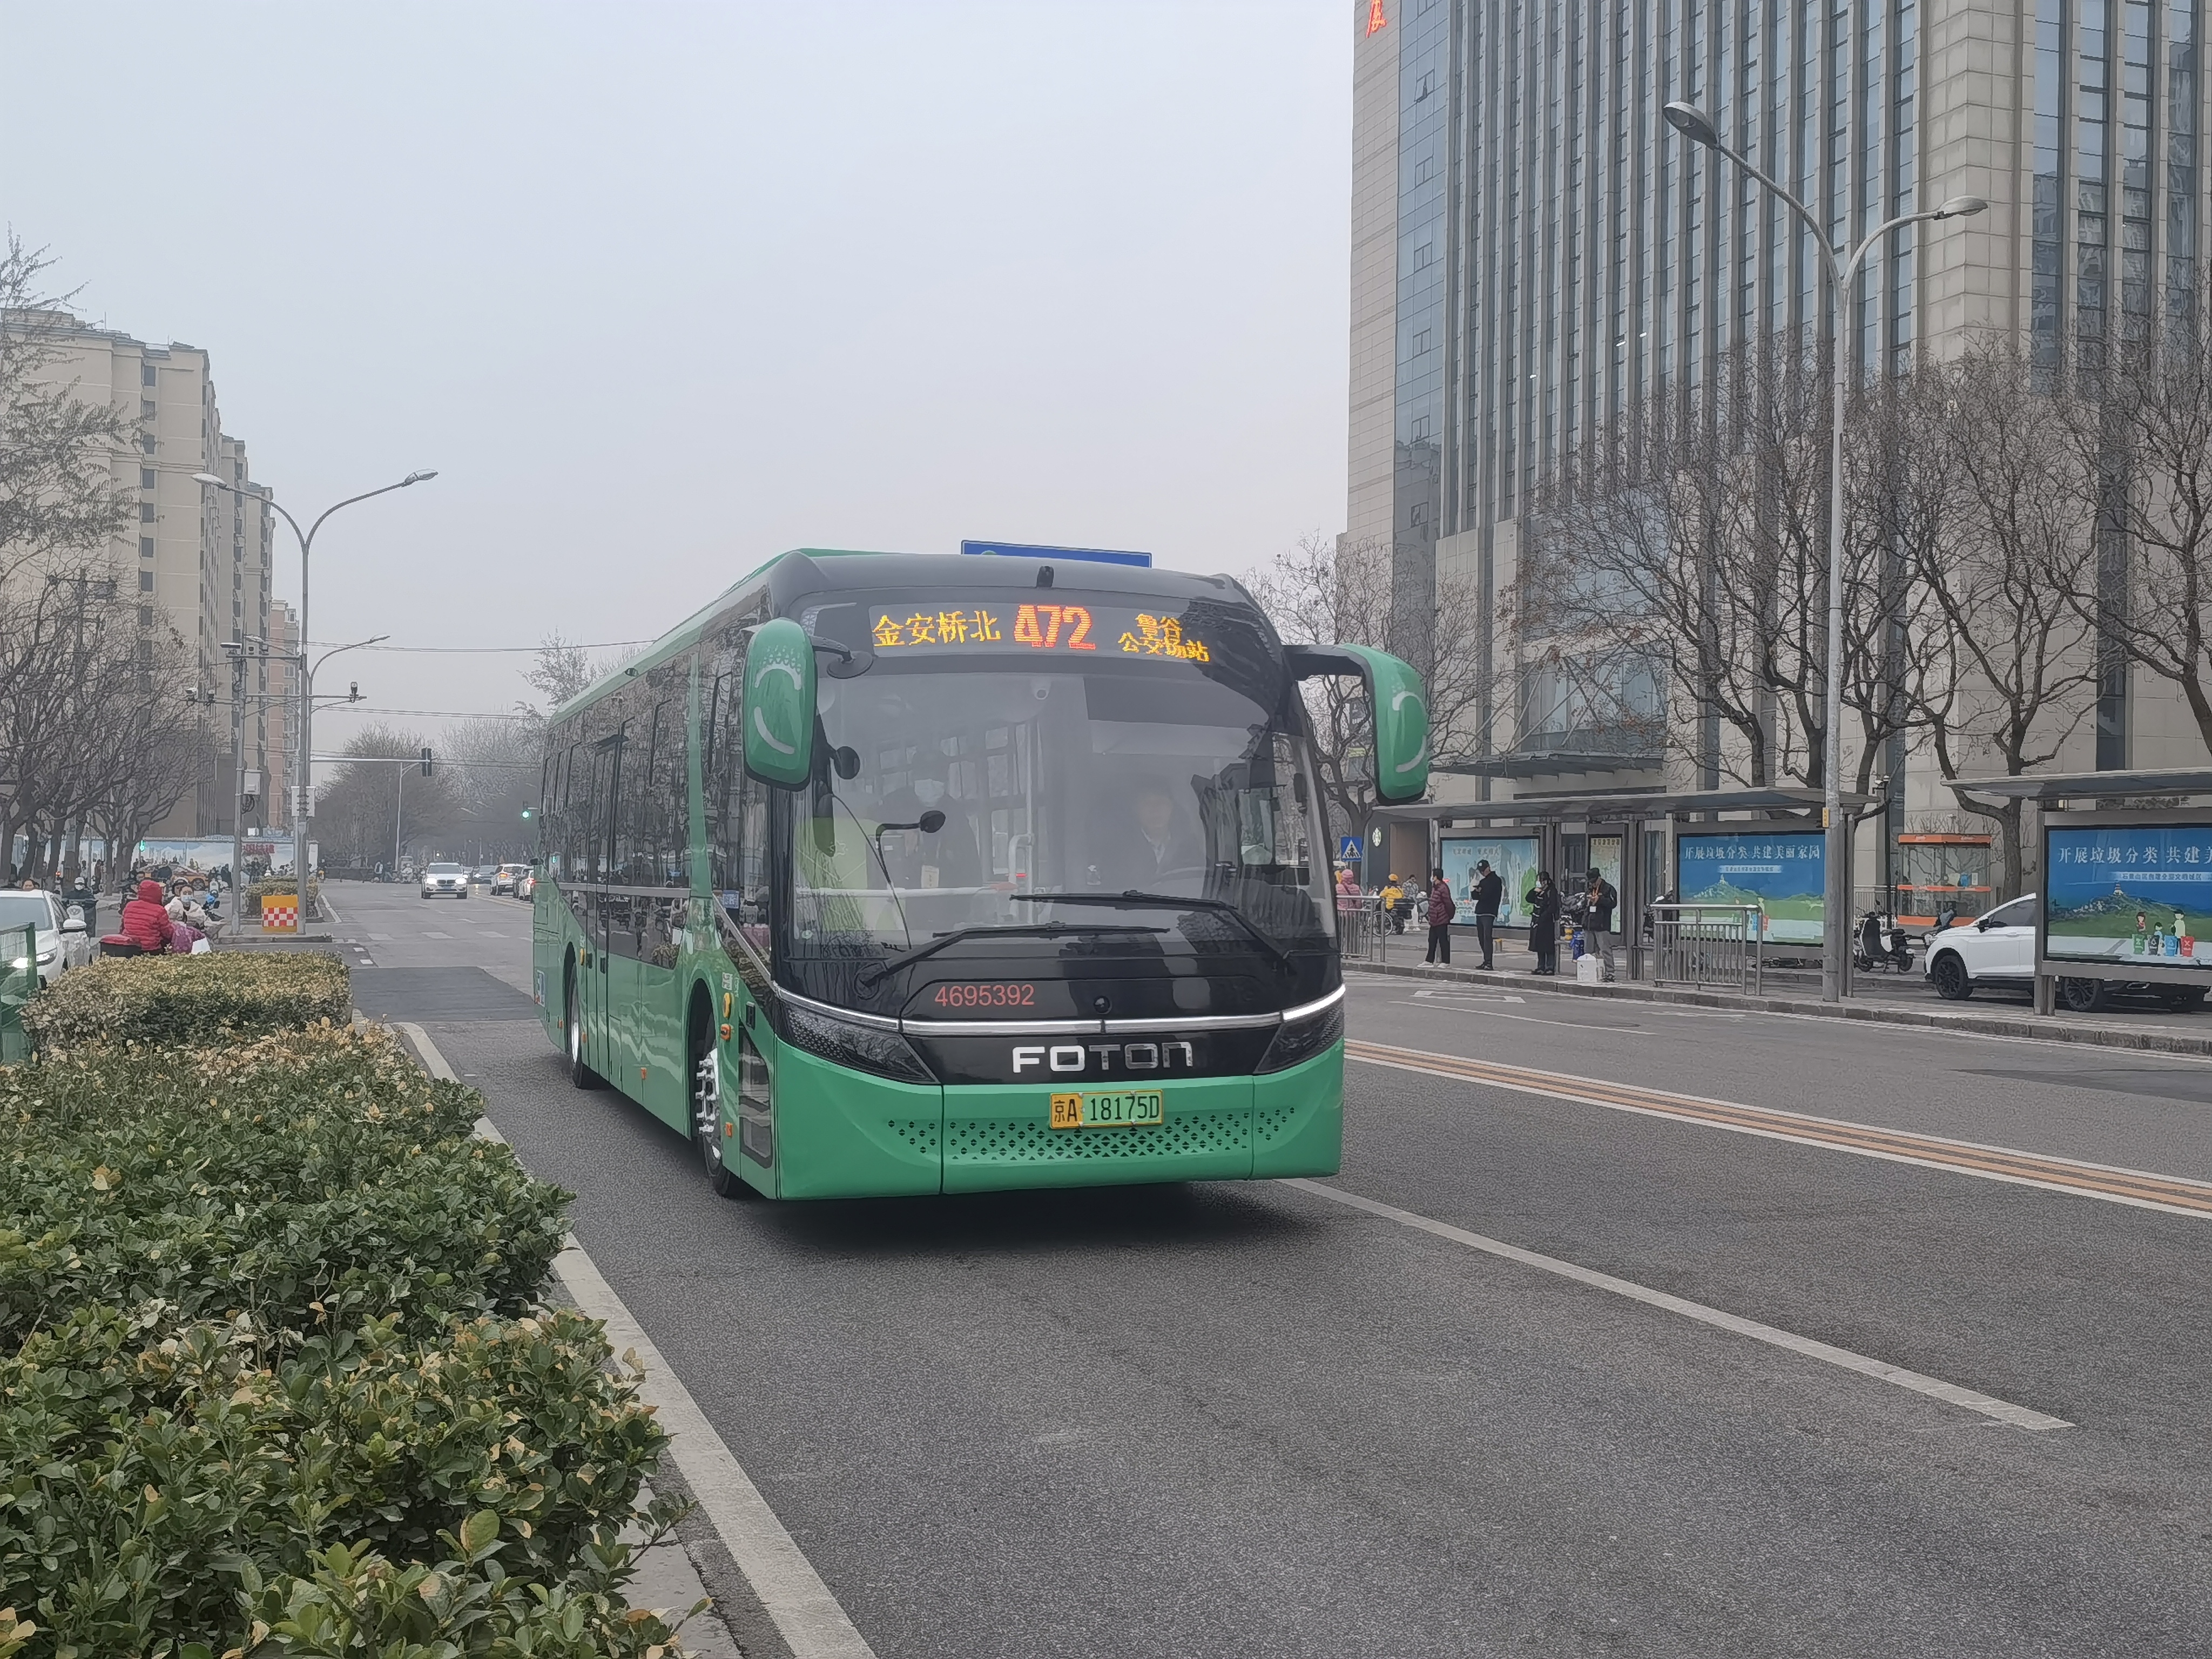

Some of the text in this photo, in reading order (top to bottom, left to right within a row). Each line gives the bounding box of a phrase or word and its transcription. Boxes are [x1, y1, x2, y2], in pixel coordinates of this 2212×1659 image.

[872, 610, 1001, 646] 金安桥北
[1014, 604, 1096, 650] 472
[2058, 846, 2158, 864] 开展垃圾分类
[934, 984, 1035, 1007] 4695392
[1012, 1042, 1193, 1073] FOTON
[1090, 1095, 1159, 1121] 18175D
